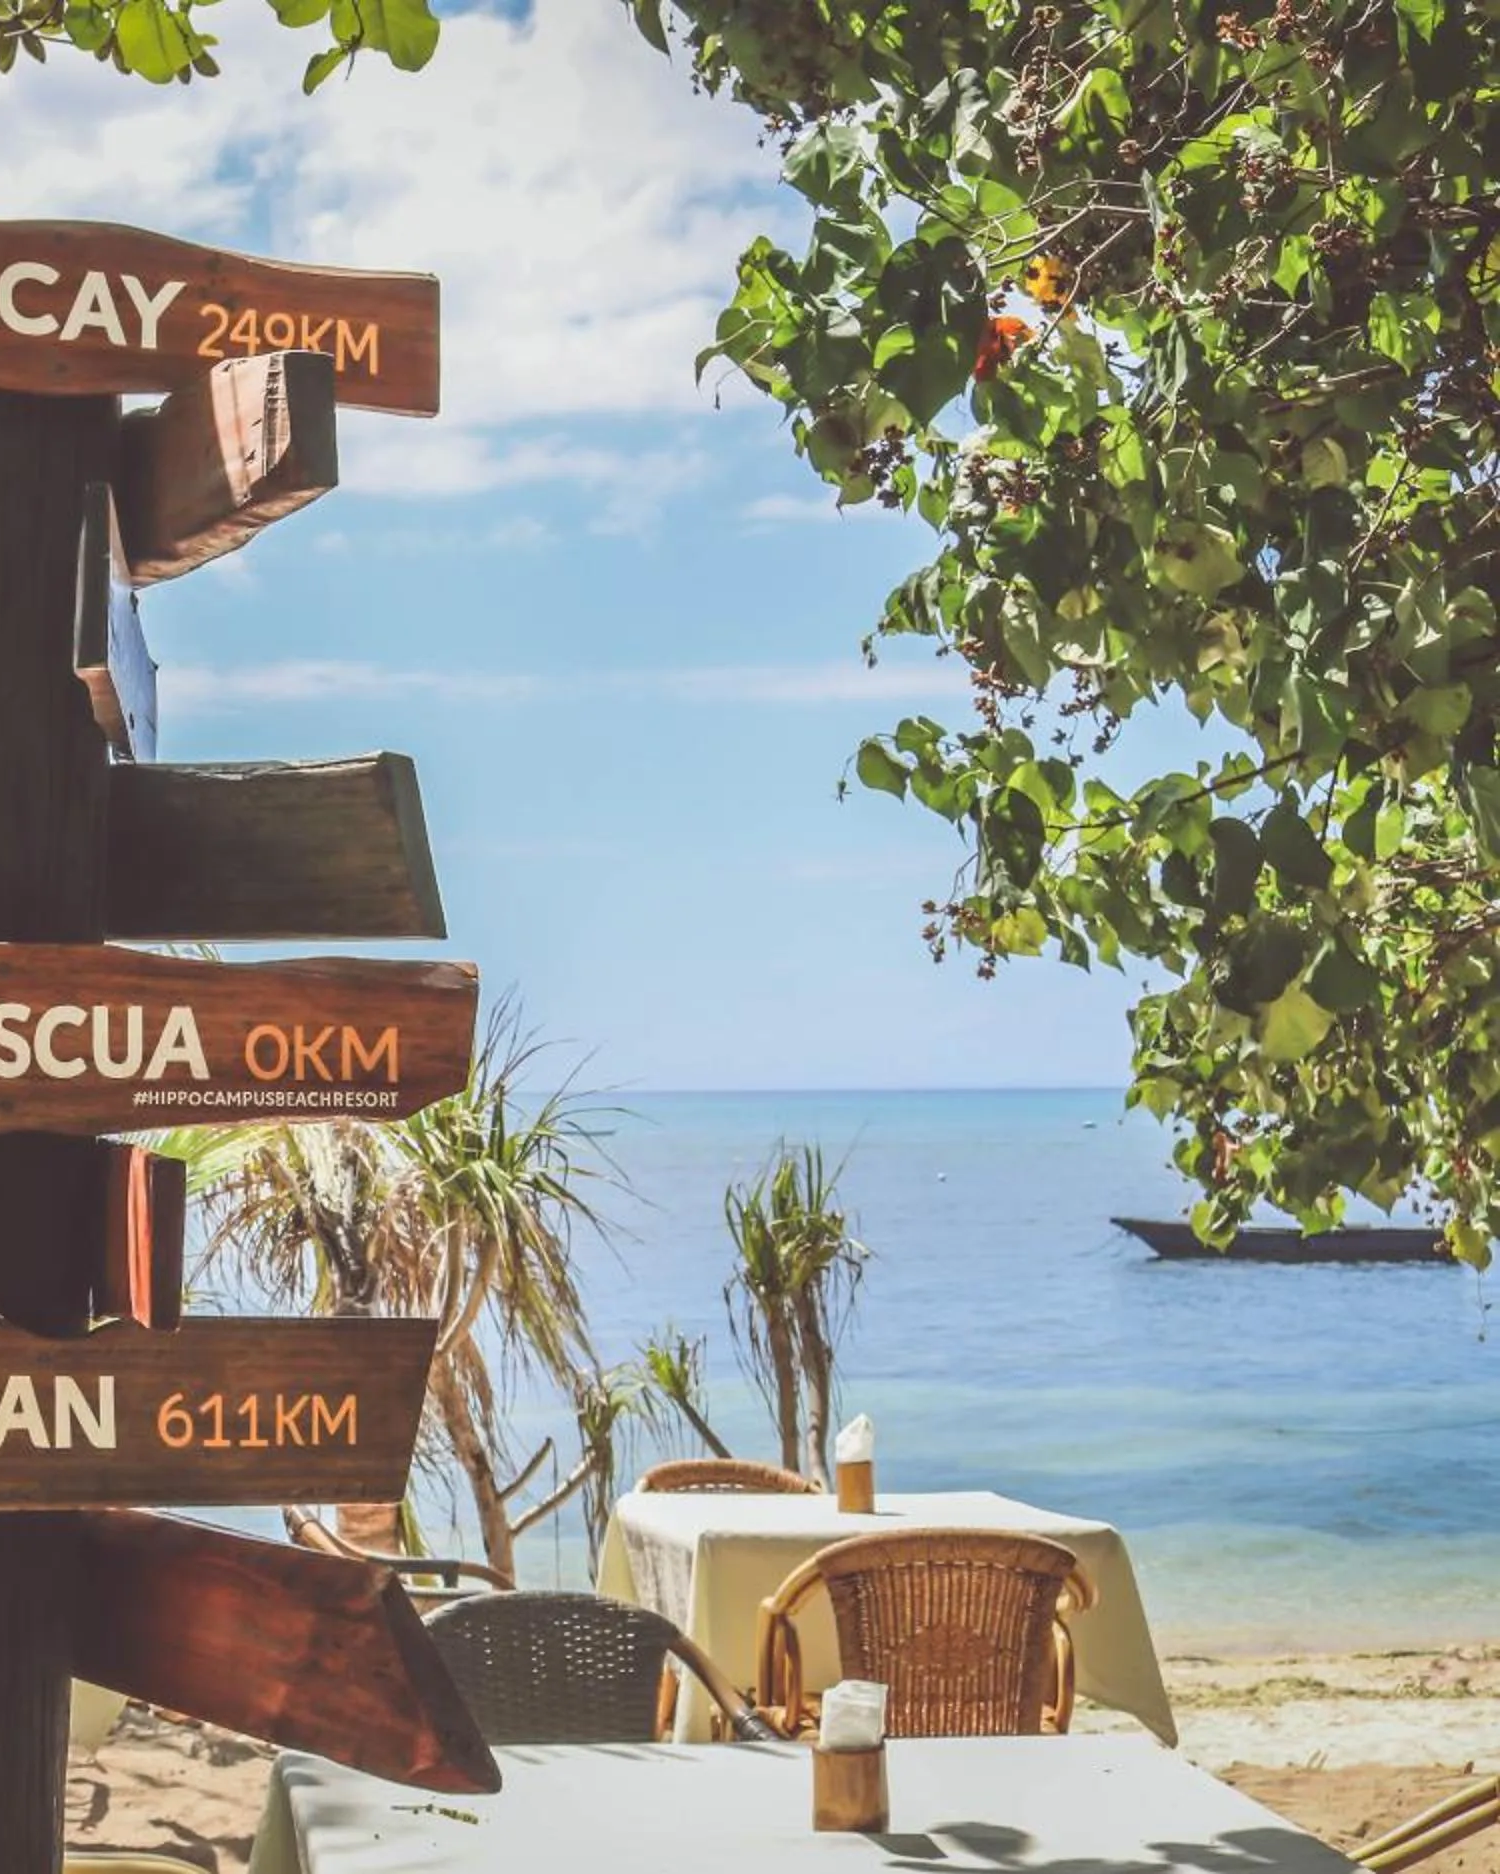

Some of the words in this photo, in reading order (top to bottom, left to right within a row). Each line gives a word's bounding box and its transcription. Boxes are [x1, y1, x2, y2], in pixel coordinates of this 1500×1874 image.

[197, 302, 380, 376] 249KM
[132, 1090, 400, 1109] #HIPPOCAMPUSBEACHRESORT
[156, 1391, 360, 1450] 611KM
